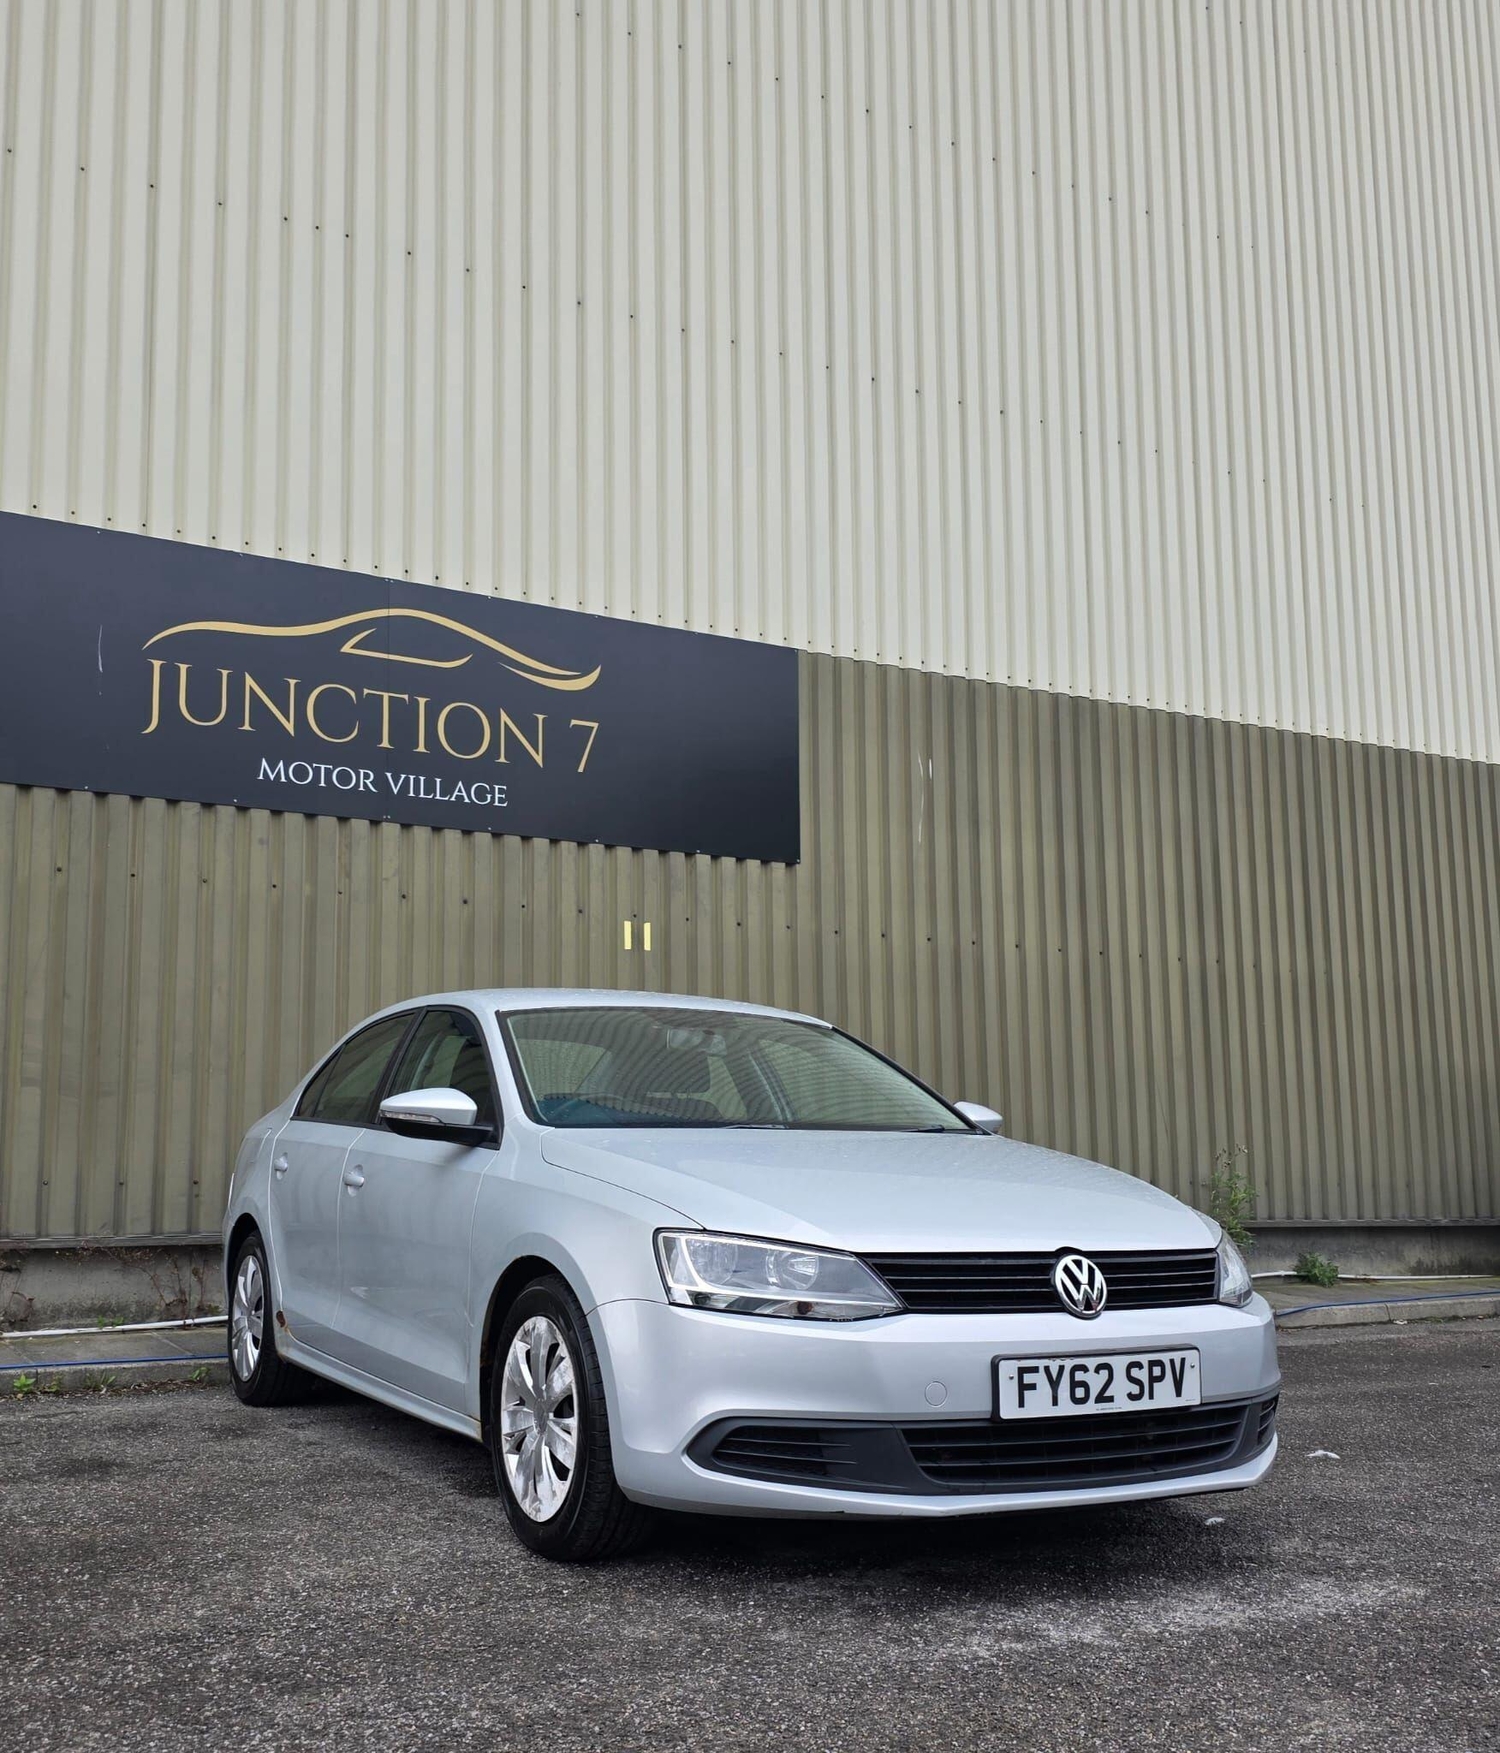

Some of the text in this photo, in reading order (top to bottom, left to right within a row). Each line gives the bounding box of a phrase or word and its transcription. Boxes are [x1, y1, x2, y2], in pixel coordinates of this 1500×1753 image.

[142, 659, 599, 772] JUNCTION 7
[257, 757, 508, 807] MOTOR VILLAGE
[1018, 1357, 1186, 1408] FY62 SPV
